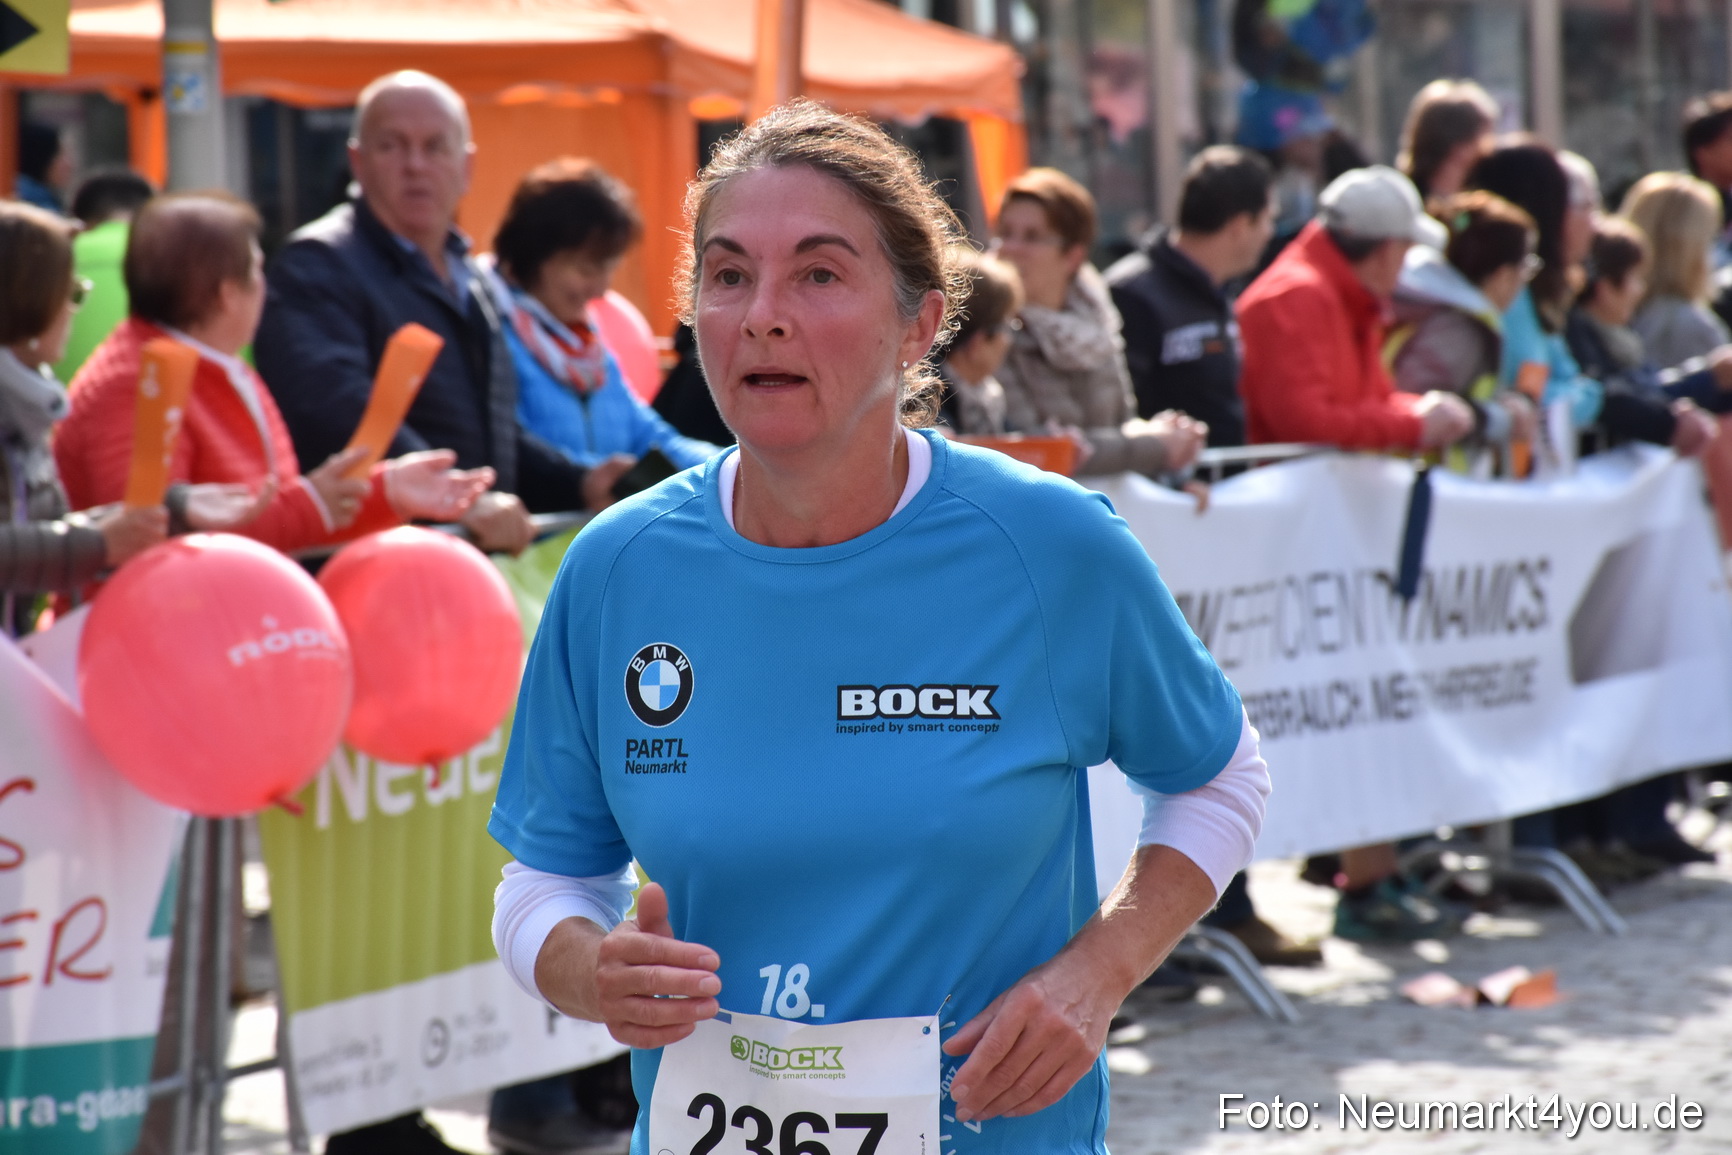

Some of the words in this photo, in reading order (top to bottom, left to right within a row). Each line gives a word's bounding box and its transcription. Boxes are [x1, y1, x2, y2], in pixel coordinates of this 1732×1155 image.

[631, 645, 689, 673] BMW
[838, 685, 1000, 720] BOCK
[836, 722, 885, 735] inspired
[888, 722, 903, 735] by
[907, 722, 944, 733] smart
[948, 722, 1000, 734] concepts
[626, 738, 689, 759] PARTL
[625, 760, 687, 775] Neumarkt
[759, 963, 825, 1019] 18.
[751, 1040, 845, 1071] BOCK
[749, 1065, 769, 1079] inspired
[770, 1070, 781, 1080] by
[782, 1071, 806, 1080] smart
[809, 1071, 846, 1080] concepts
[687, 1092, 889, 1155] 2367
